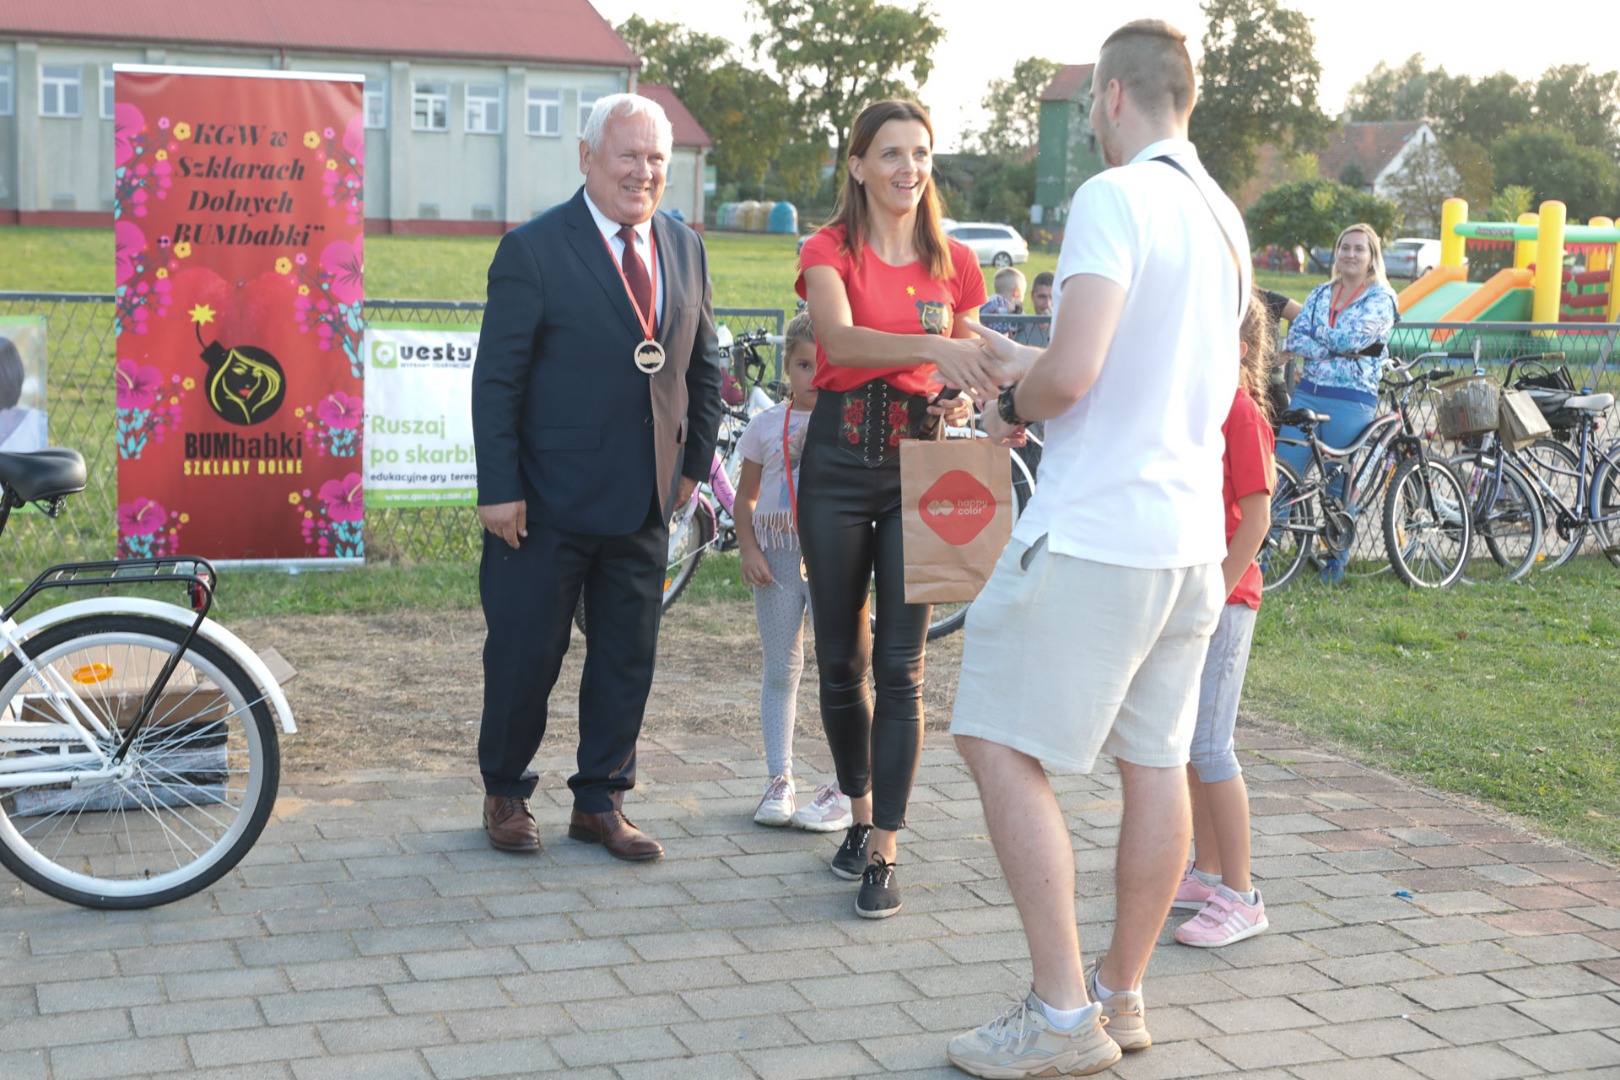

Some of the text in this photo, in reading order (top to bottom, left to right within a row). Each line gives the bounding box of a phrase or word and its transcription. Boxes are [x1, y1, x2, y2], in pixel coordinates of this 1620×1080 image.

[193, 123, 288, 147] KGW w
[175, 156, 305, 181] Szklarach
[187, 190, 293, 217] Dolnych
[371, 415, 446, 440] Ruszaj
[184, 432, 303, 459] BUMbabki
[370, 444, 475, 468] po skarb!
[183, 459, 303, 476] SZKLARY DOLNE
[370, 471, 428, 484] edukacyjne
[430, 474, 447, 483] gry
[957, 499, 988, 509] happy
[957, 506, 983, 515] color
